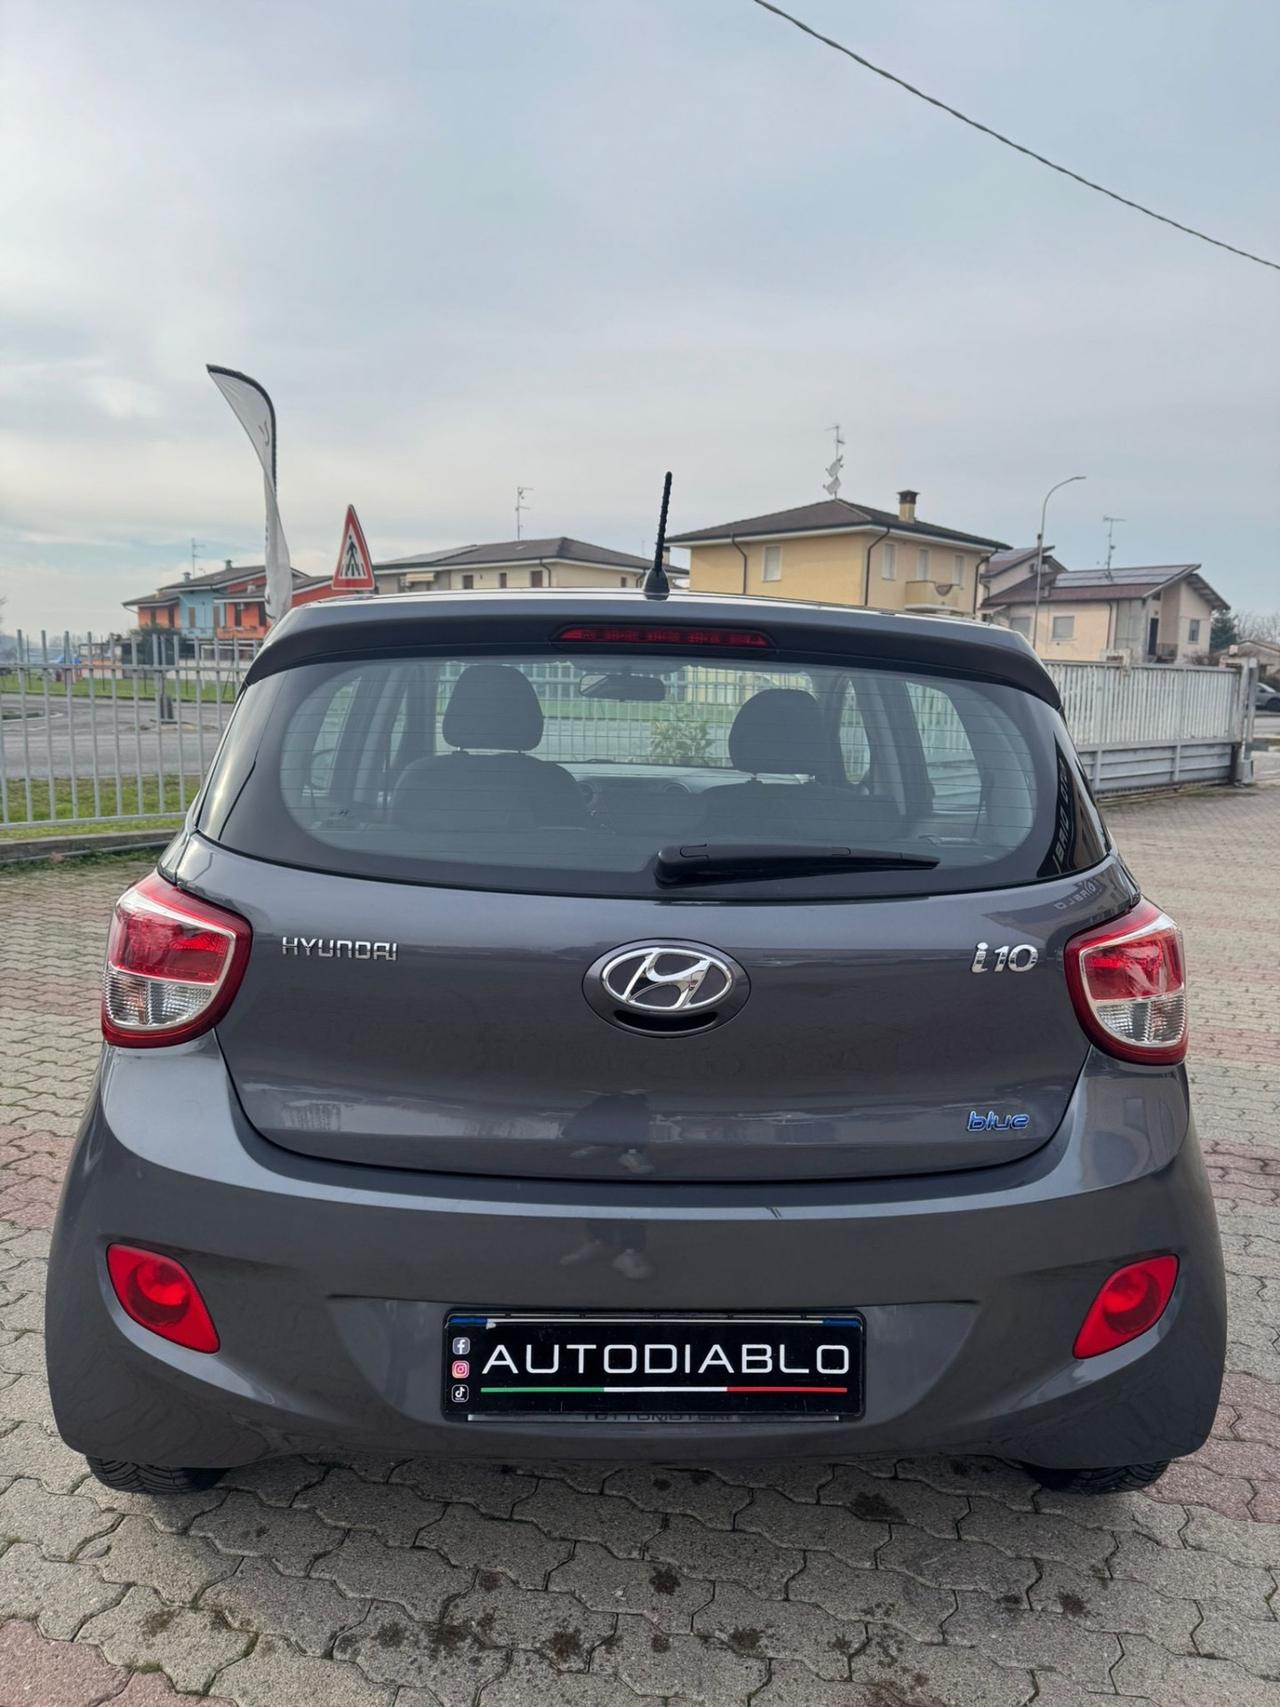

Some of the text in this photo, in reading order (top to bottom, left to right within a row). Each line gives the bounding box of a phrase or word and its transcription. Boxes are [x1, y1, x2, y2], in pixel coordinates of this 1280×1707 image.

[282, 936, 397, 960] HYUNDAI
[971, 942, 1038, 973] i10
[967, 1111, 1030, 1131] blue
[481, 1344, 849, 1374] AUTODIABLO
